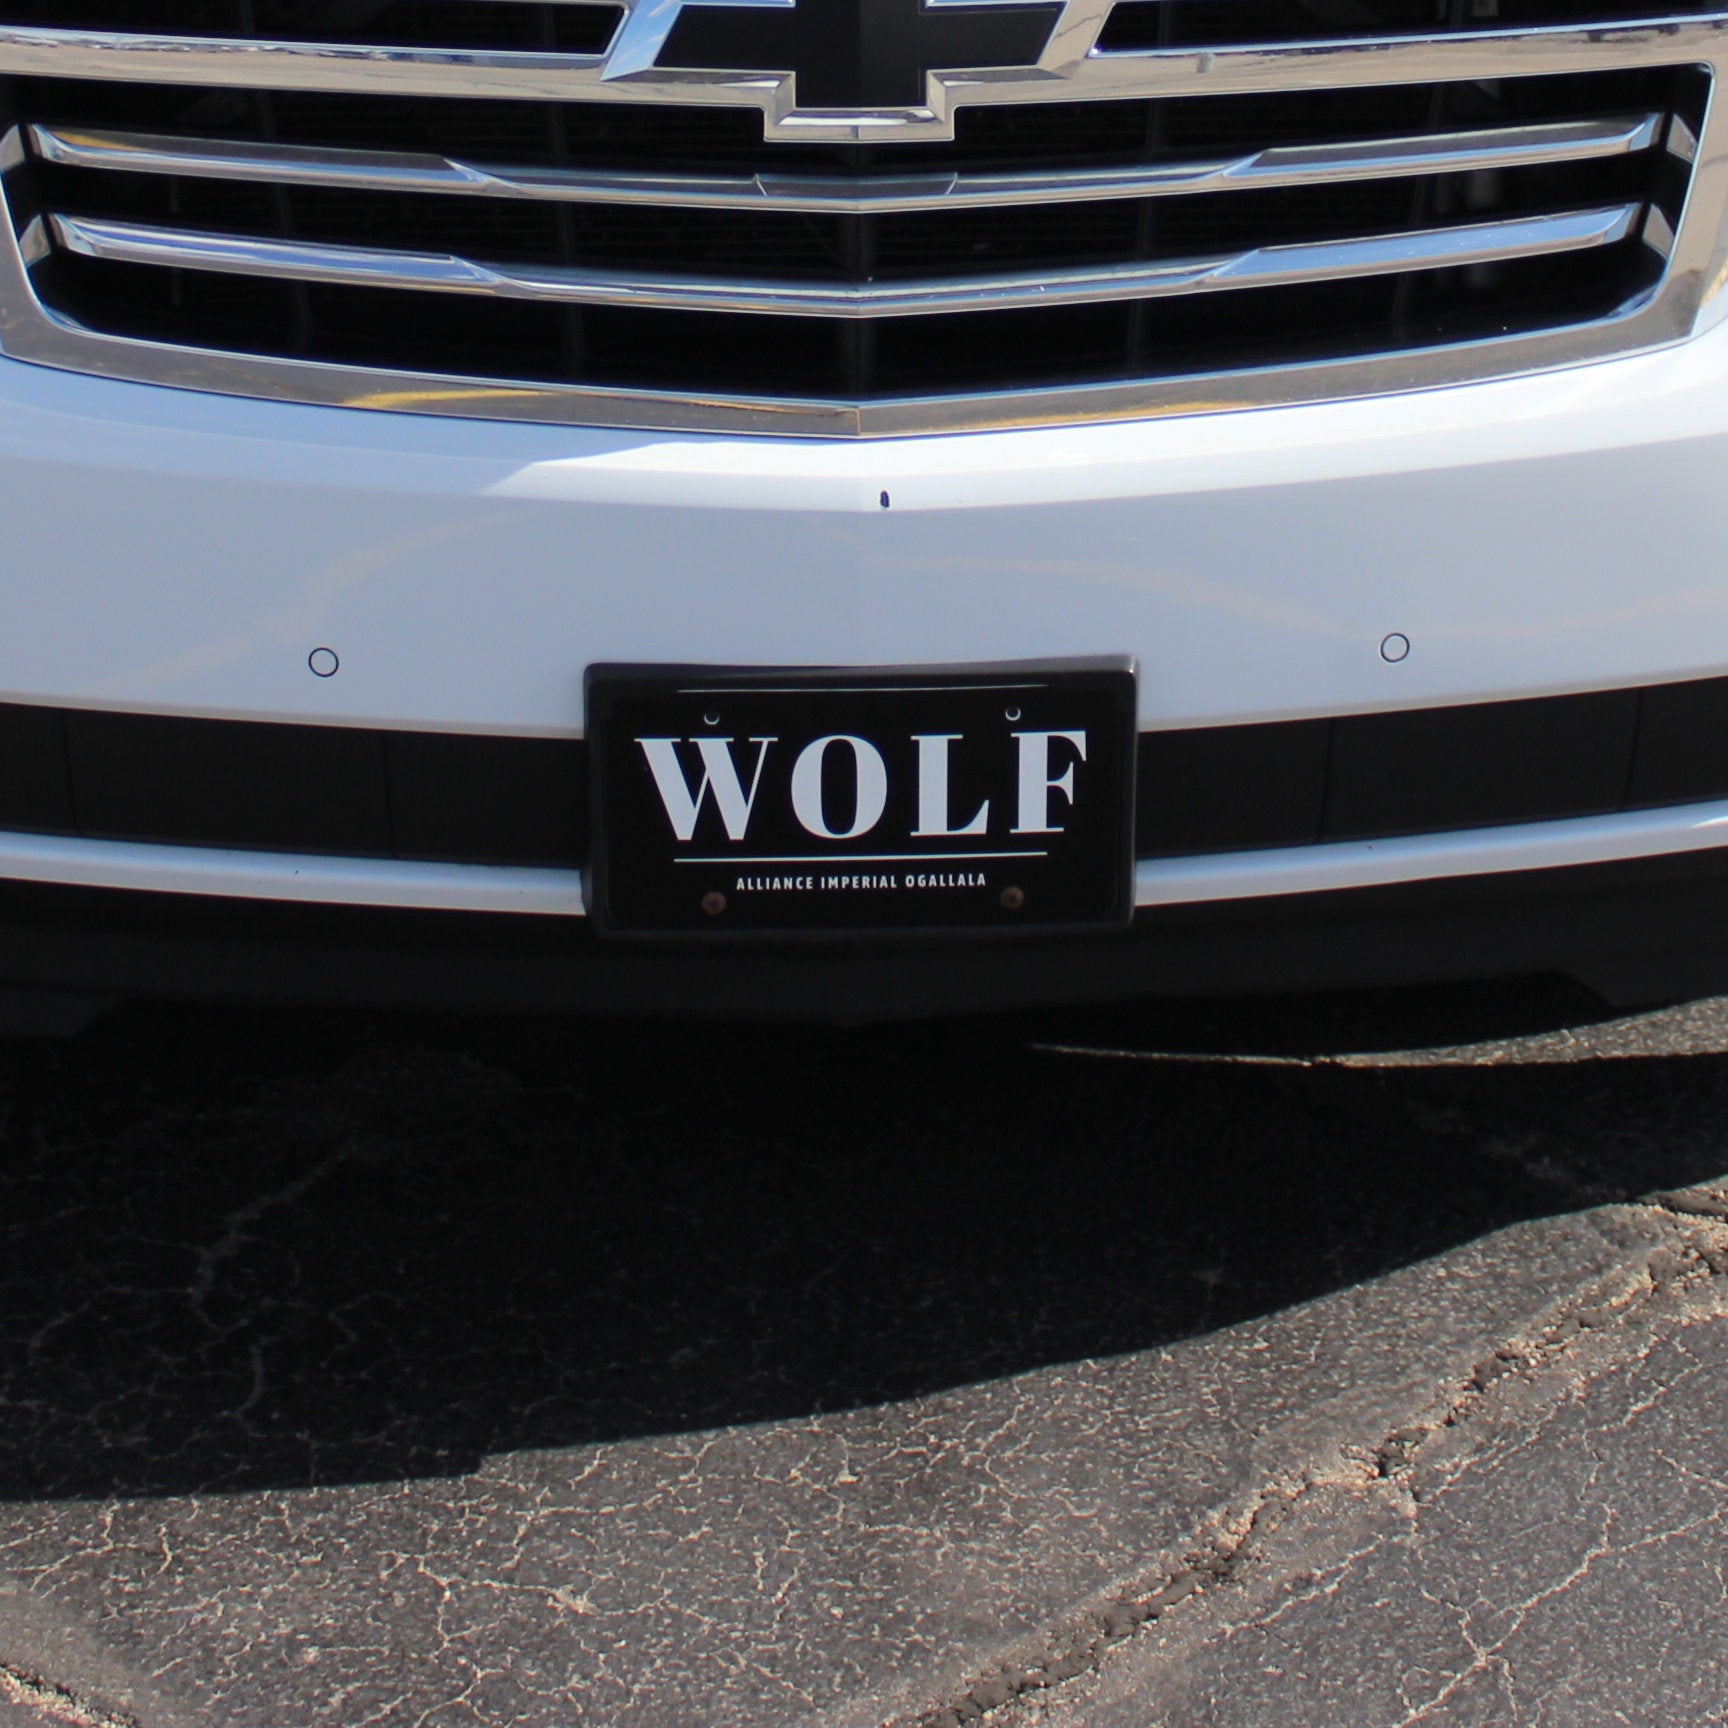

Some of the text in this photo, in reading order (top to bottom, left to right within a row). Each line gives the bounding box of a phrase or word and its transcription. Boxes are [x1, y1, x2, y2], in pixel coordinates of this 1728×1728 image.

[633, 729, 1088, 842] WOLF
[735, 873, 987, 891] ALLIANCE IMPERIAL OGALLALA
